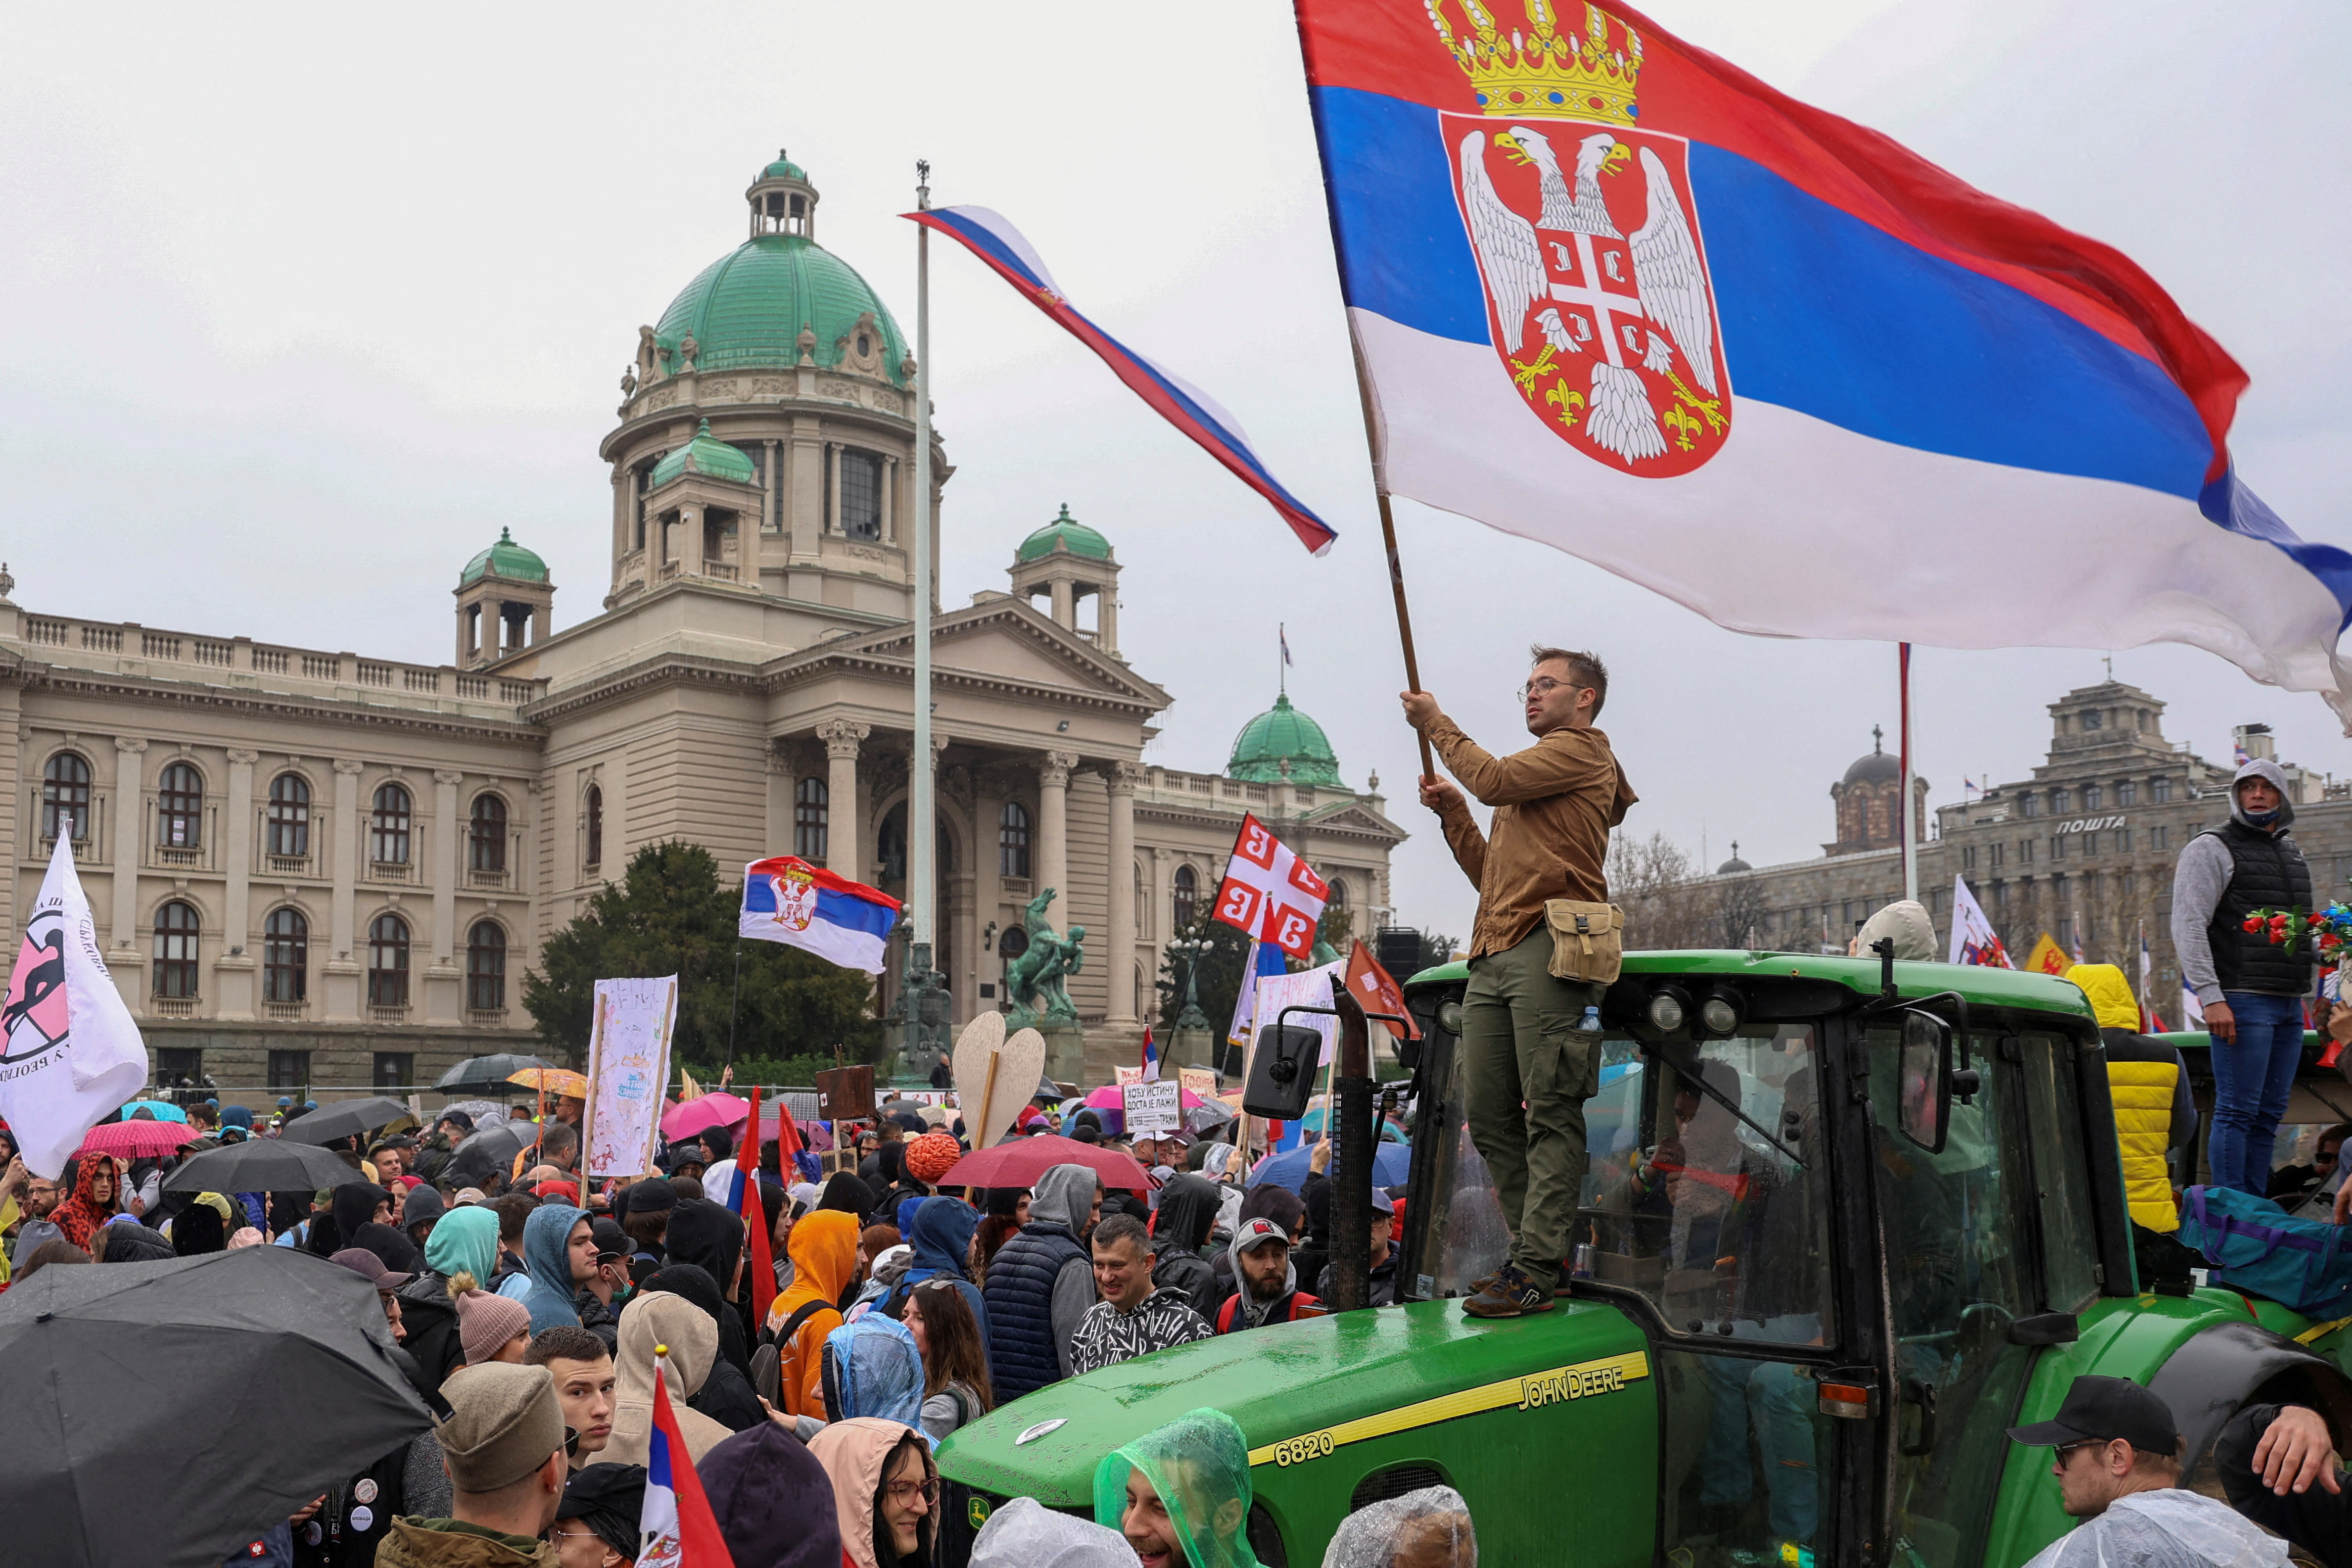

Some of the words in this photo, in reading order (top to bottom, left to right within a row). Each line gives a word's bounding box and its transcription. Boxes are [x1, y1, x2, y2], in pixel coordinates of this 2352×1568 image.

[2055, 815, 2126, 834] ПОШТА
[1128, 1088, 1145, 1098] ХОЋУ
[1147, 1085, 1175, 1096] ИСТИНУ
[1127, 1099, 1147, 1112] ДОСТА
[1148, 1099, 1154, 1108] ЈЕ
[1156, 1097, 1176, 1108] ЛАЖИ
[1159, 1113, 1177, 1126] ТРАЖИ
[1274, 1432, 1335, 1468] 6820
